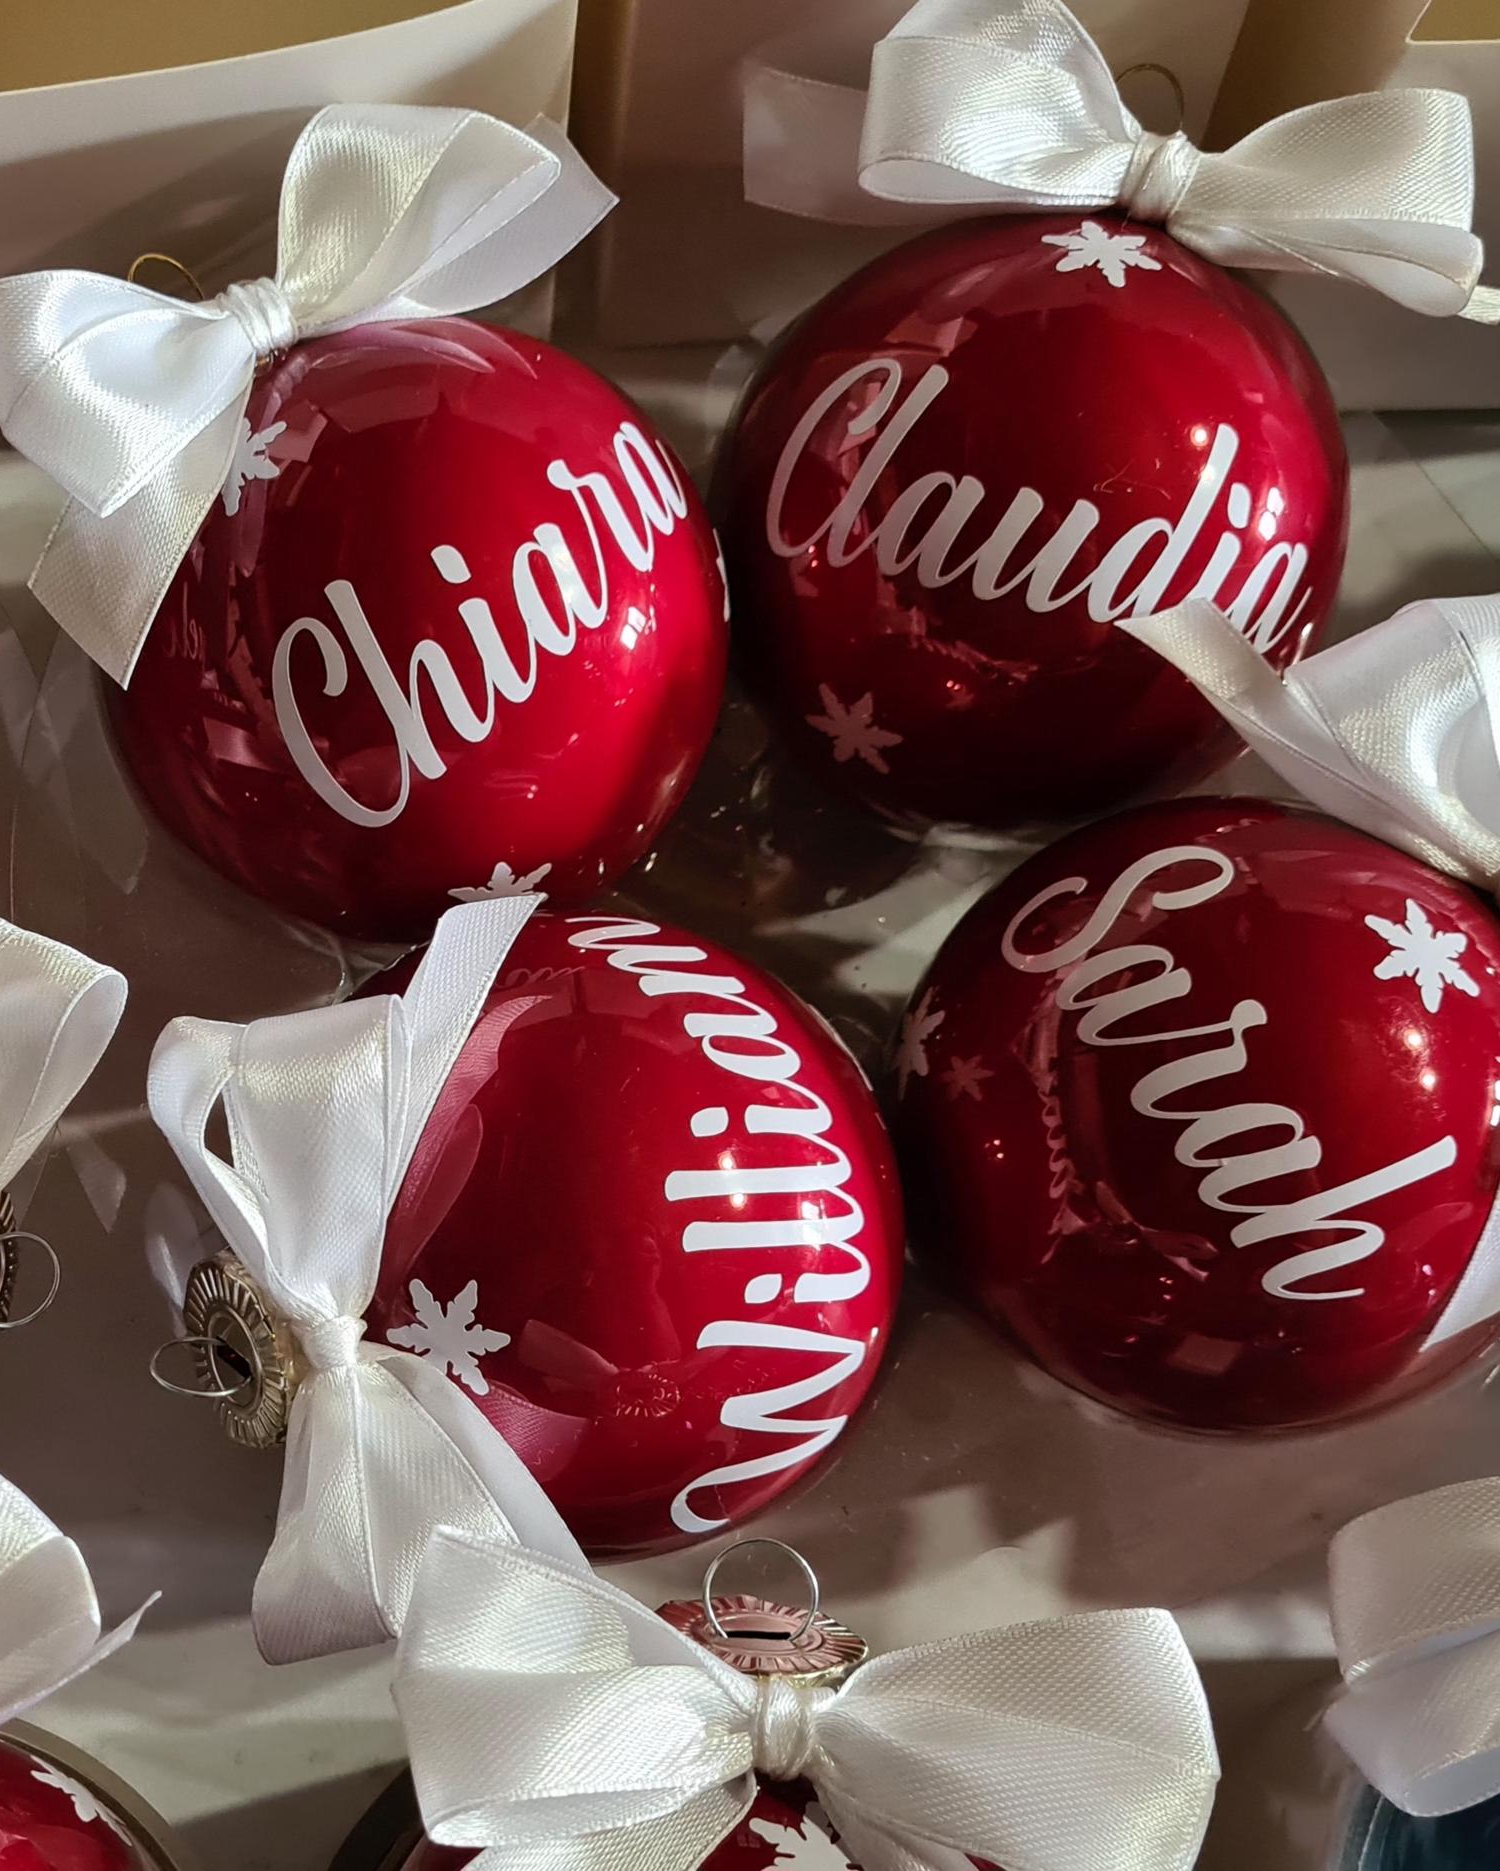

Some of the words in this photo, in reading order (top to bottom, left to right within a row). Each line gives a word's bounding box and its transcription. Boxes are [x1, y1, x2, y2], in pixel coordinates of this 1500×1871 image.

[271, 421, 688, 828] Chiara
[766, 358, 1313, 654] Claudia
[565, 915, 872, 1533] William
[1001, 846, 1458, 1301] Sarah
